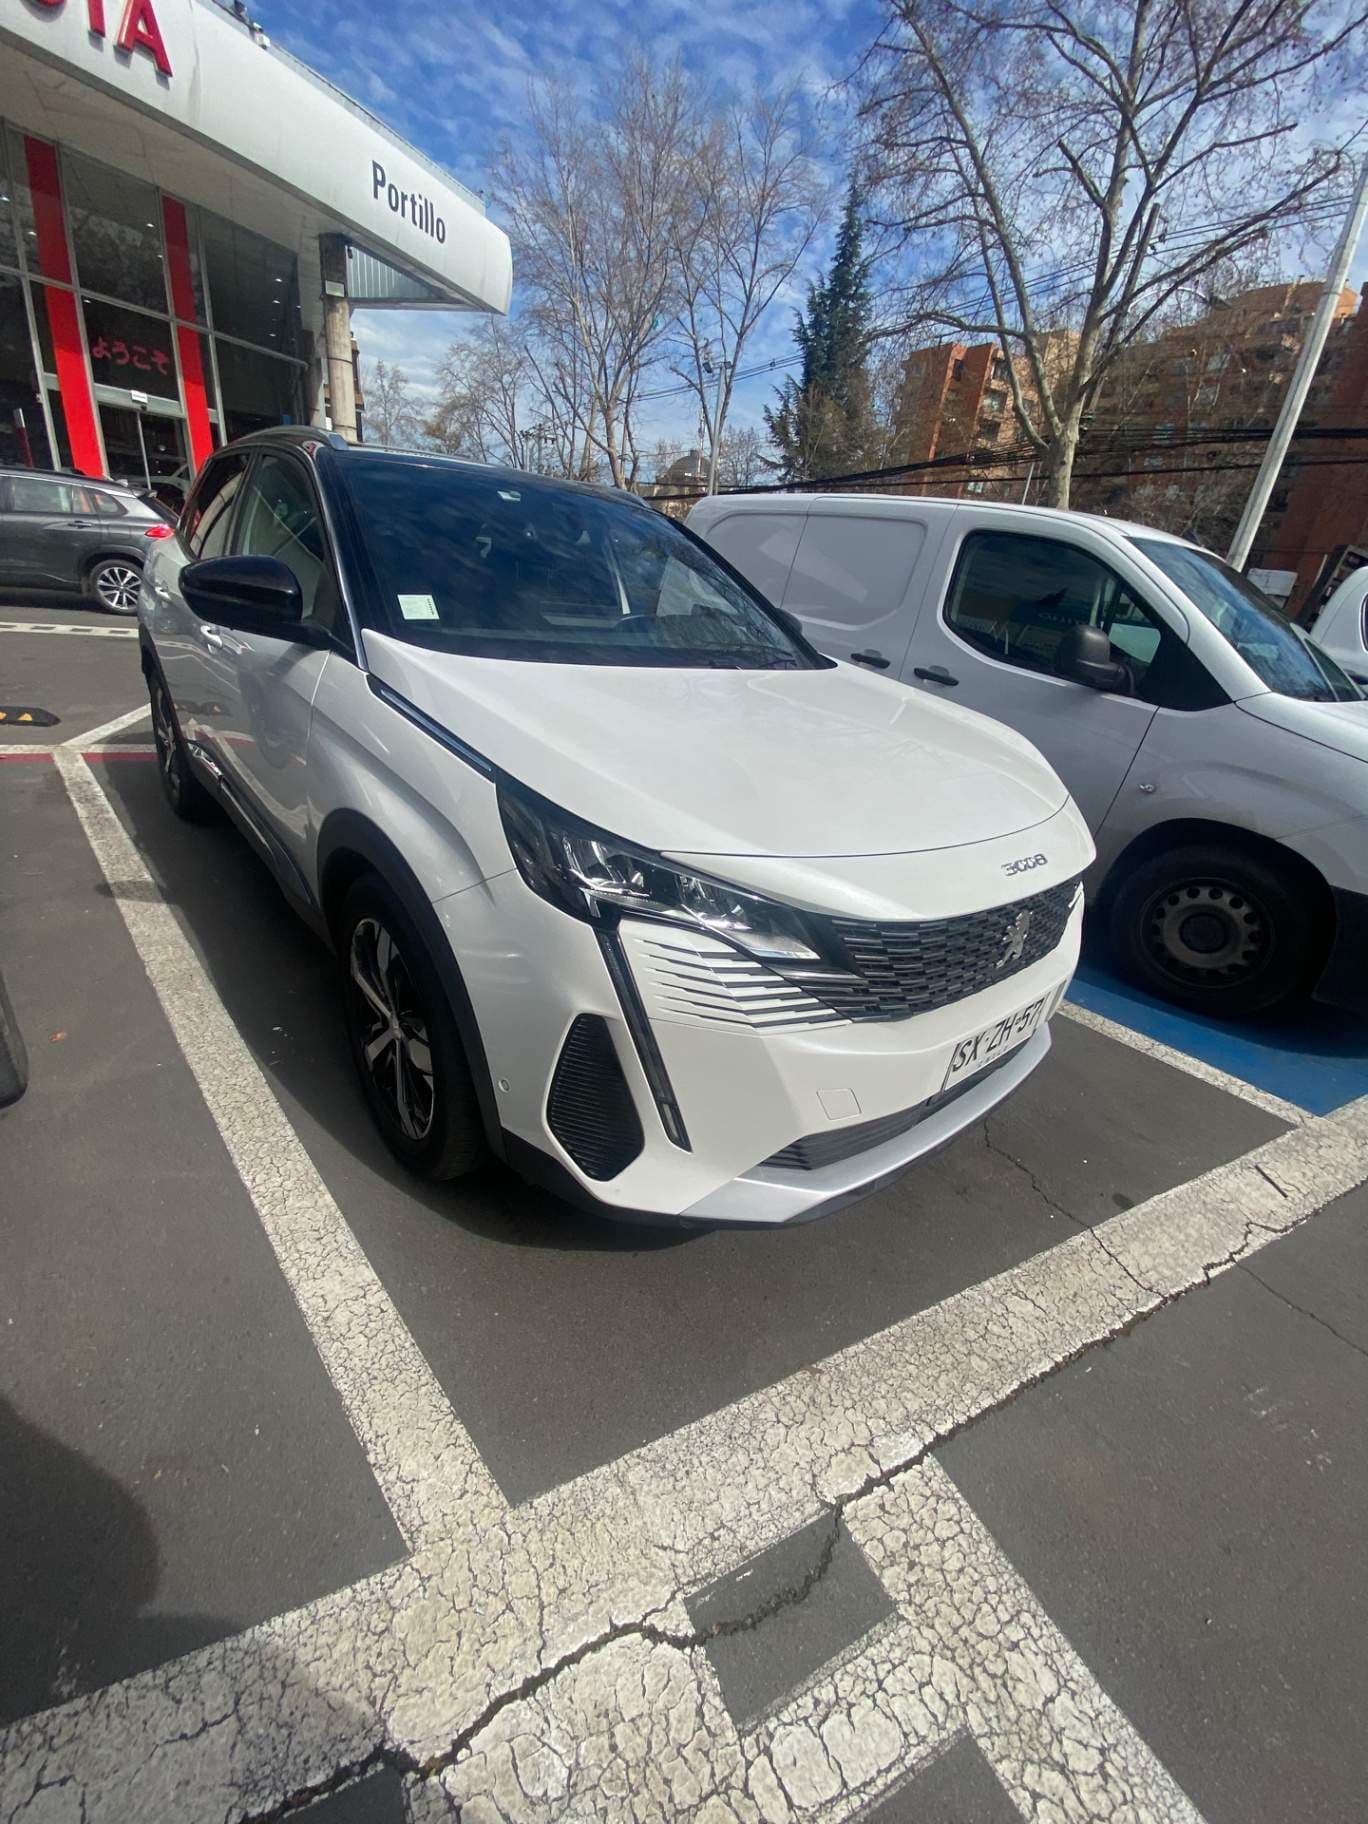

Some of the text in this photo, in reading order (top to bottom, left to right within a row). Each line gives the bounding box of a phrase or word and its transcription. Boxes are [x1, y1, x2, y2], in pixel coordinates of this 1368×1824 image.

[372, 159, 446, 244] Portillo
[92, 336, 169, 375] ようこそ
[1000, 853, 1048, 876] 3008
